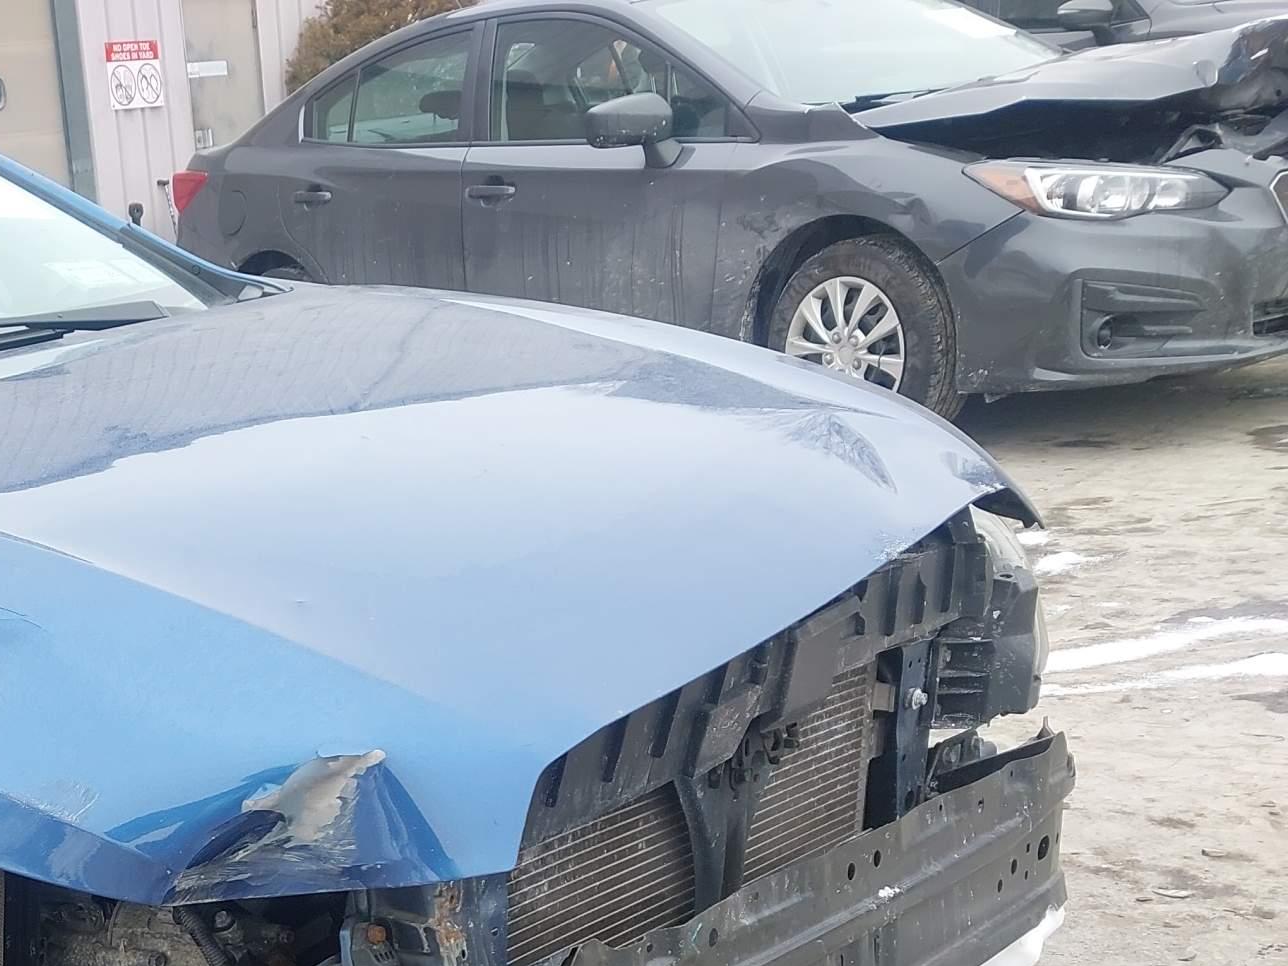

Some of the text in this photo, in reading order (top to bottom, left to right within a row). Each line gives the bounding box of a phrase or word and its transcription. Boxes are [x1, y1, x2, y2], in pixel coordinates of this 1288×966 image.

[113, 44, 122, 52] NO
[123, 43, 138, 52] OPEN
[139, 51, 154, 59] YARD
